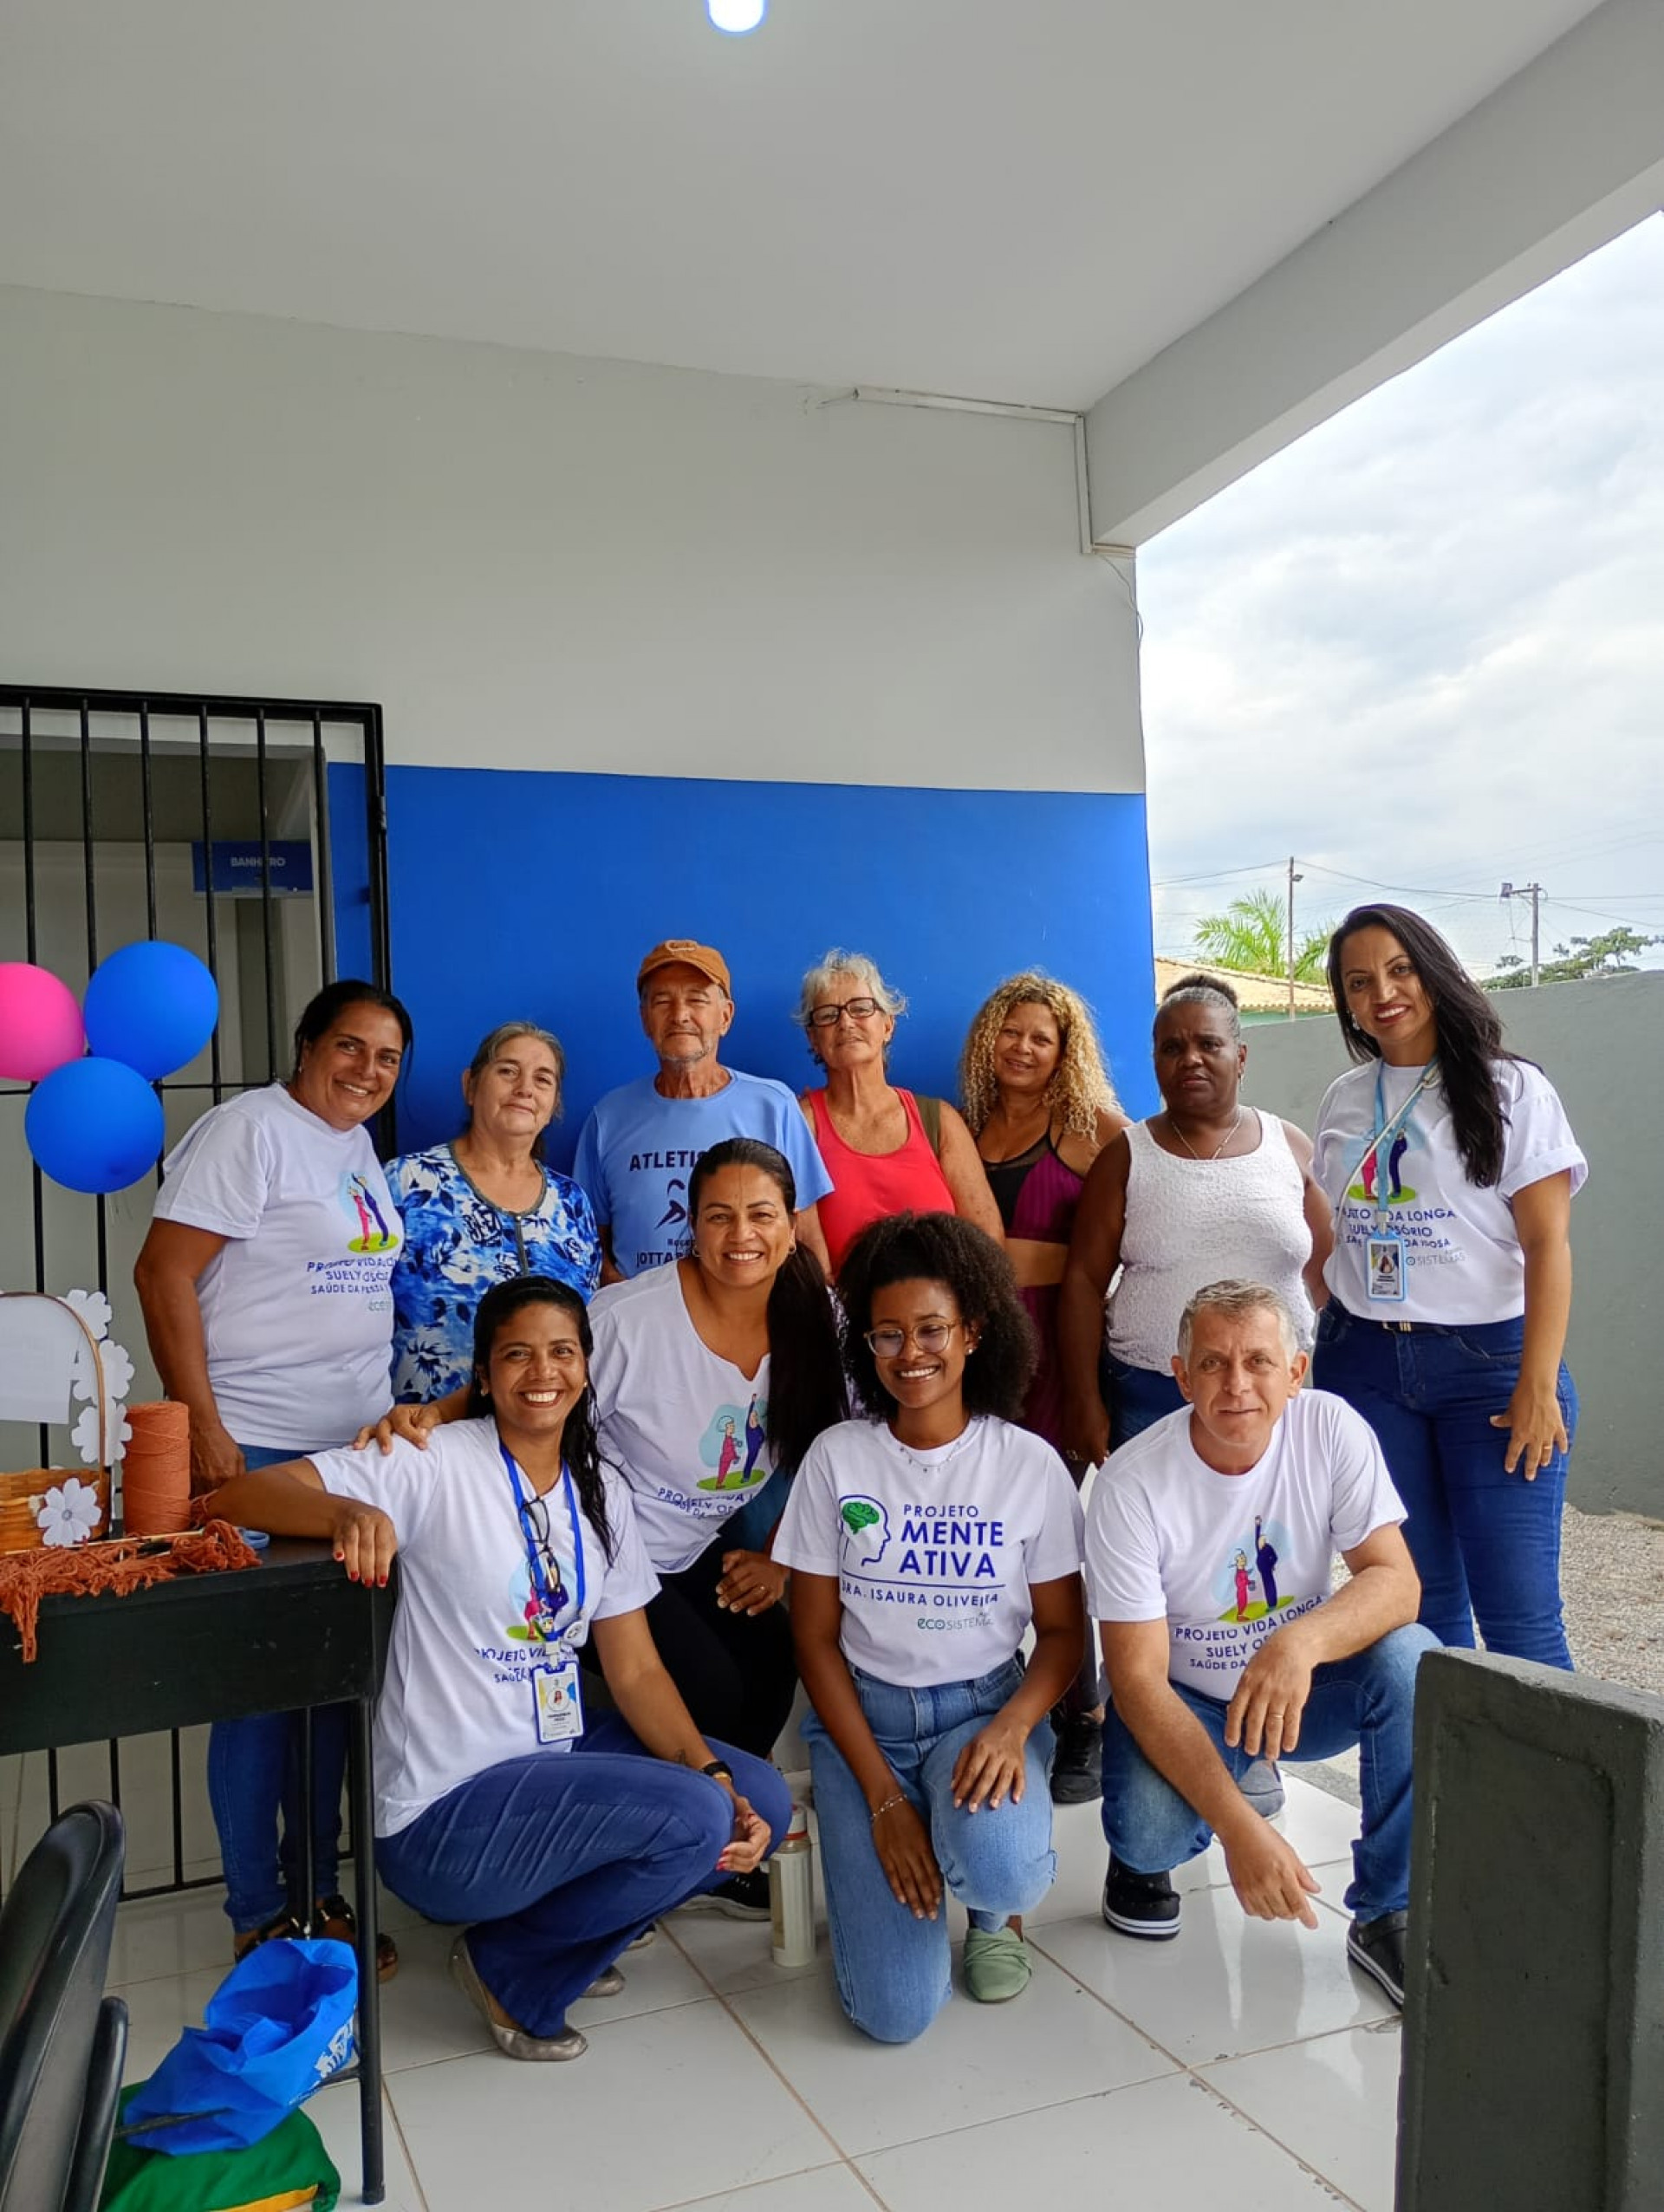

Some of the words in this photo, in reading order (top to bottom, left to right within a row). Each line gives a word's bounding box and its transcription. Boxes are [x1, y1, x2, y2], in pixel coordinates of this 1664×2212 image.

[231, 857, 287, 867] BANHRO
[1407, 1208, 1457, 1221] LONGA
[904, 1504, 979, 1518] PROJETO
[900, 1519, 1004, 1547] MENTE
[899, 1549, 997, 1578] ATIVA
[870, 1588, 928, 1606] ISAURA
[1175, 1627, 1238, 1642] PROJETO
[1243, 1617, 1277, 1636] VIDA
[1280, 1595, 1323, 1624] LONGA
[1206, 1643, 1248, 1658] SUELY
[1189, 1658, 1227, 1670] SAÚDE
[1231, 1659, 1247, 1669] DA
